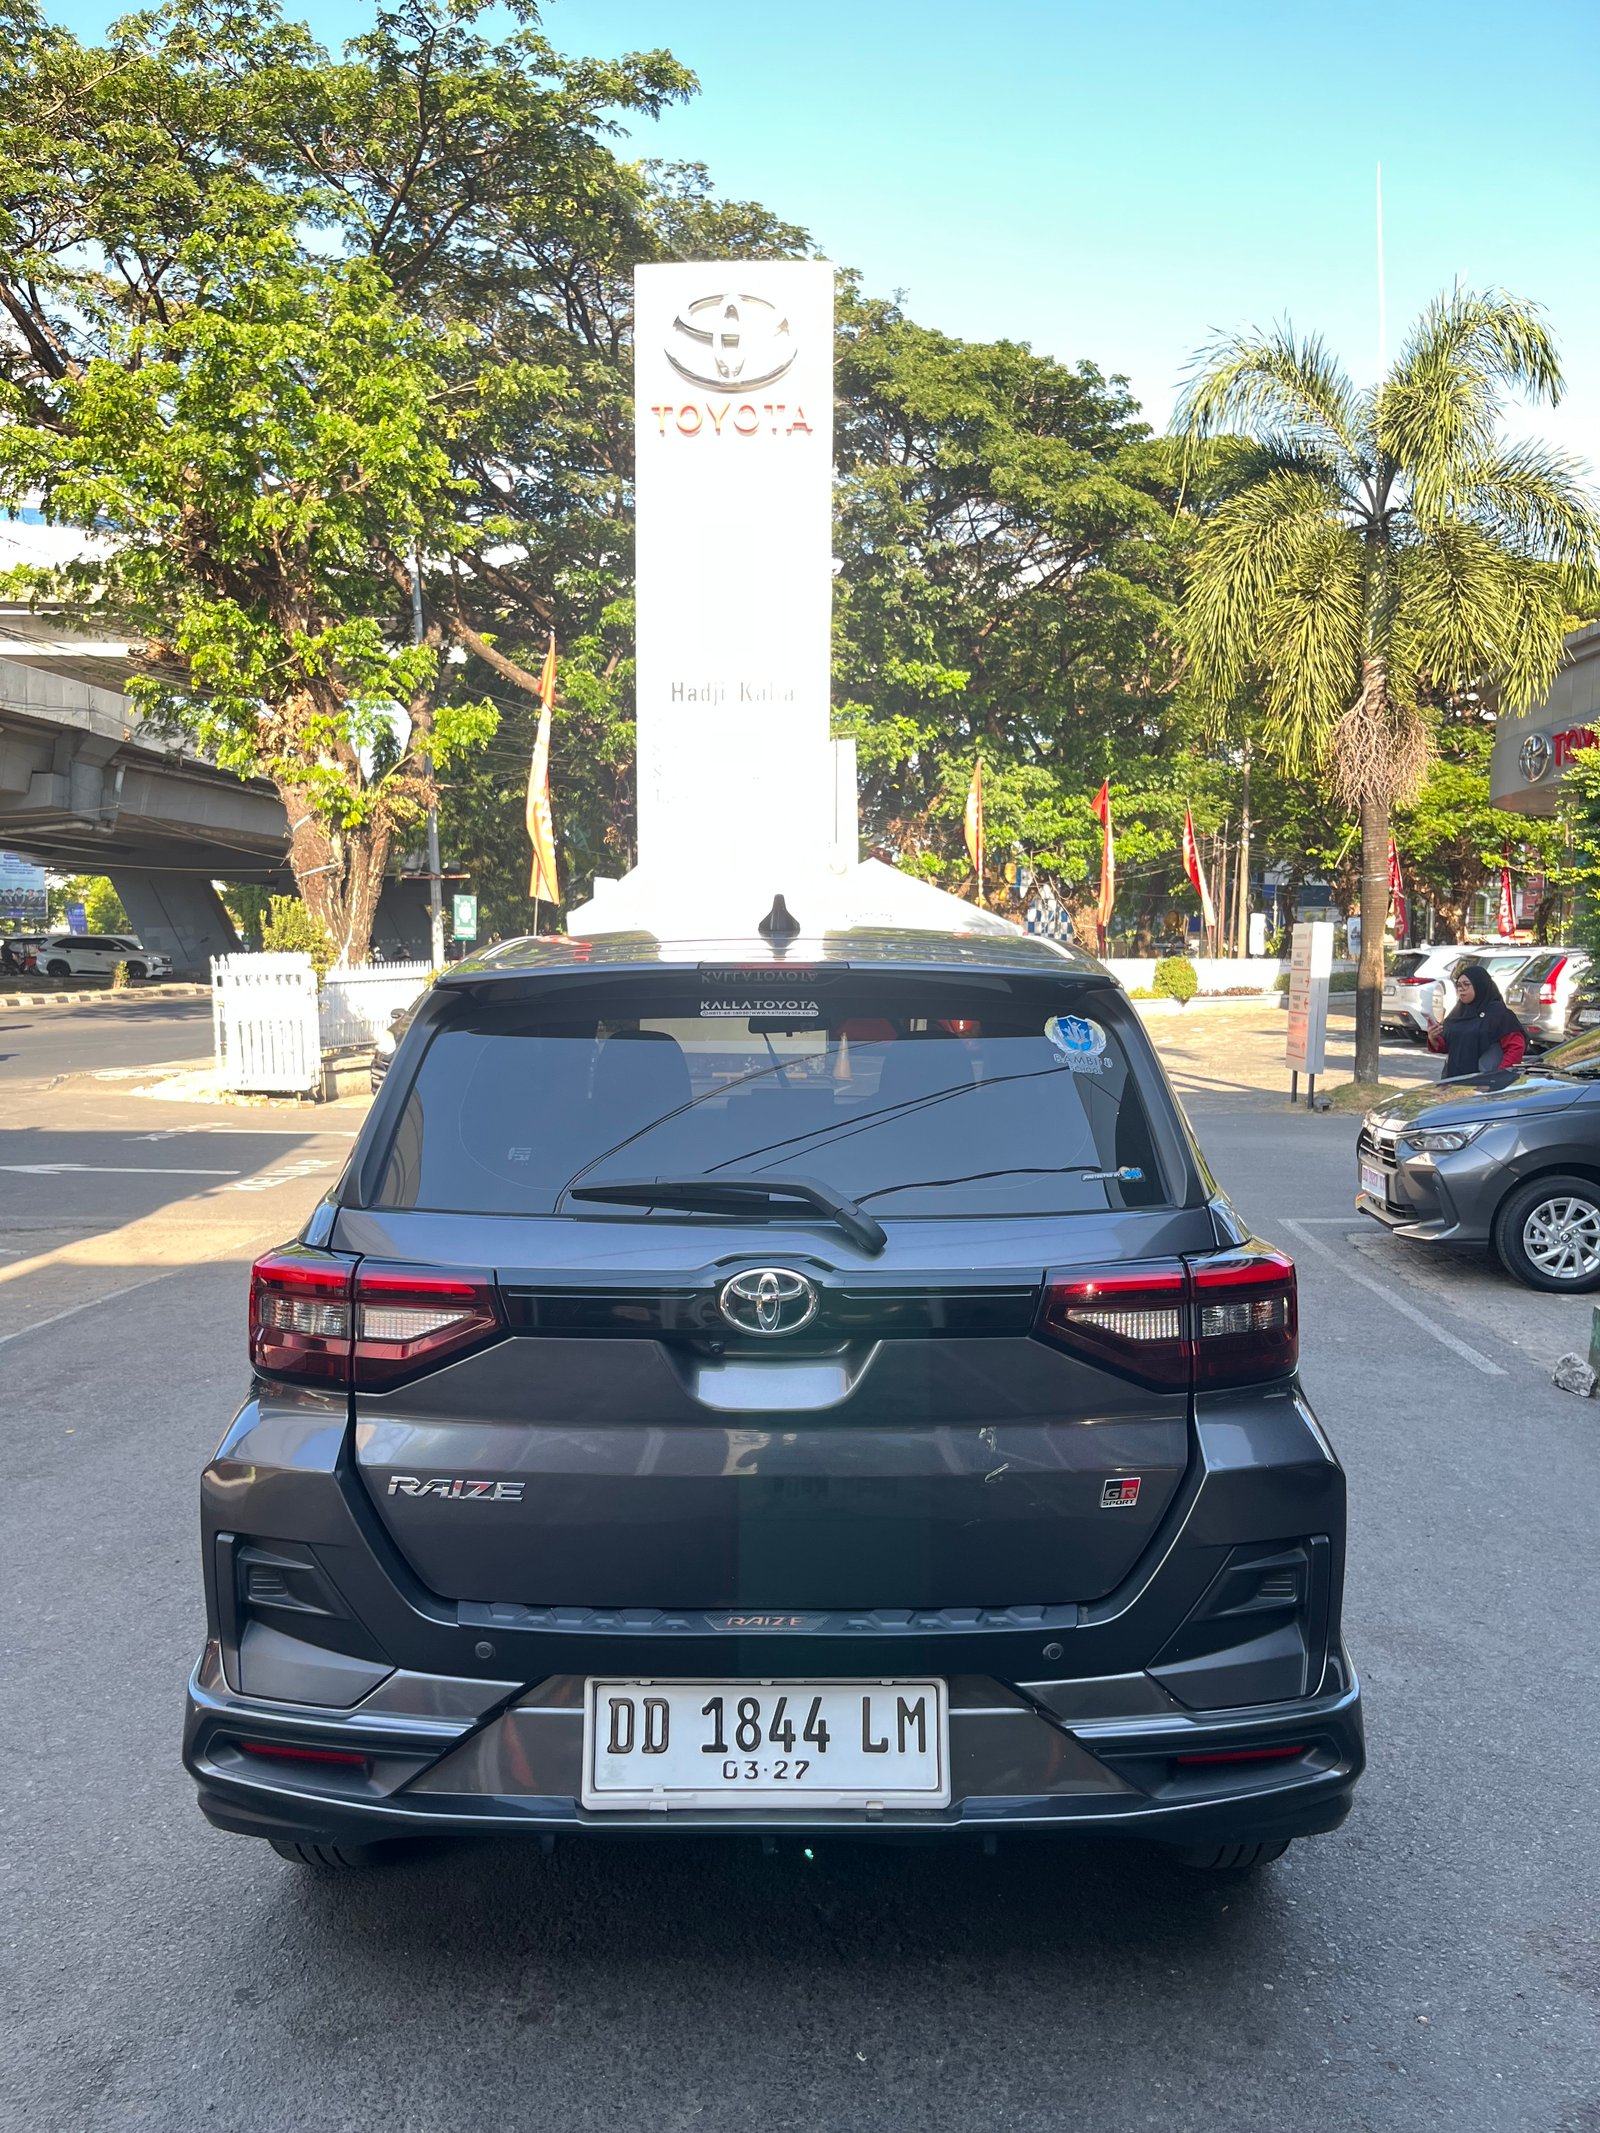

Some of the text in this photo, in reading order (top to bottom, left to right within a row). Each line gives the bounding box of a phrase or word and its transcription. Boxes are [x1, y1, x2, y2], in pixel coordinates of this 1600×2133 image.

[651, 403, 813, 437] TOYOTA
[671, 681, 795, 707] Hadji Kala
[700, 1001, 818, 1010] KALLA TOYOTA
[387, 1475, 526, 1503] RAIZE
[1105, 1487, 1136, 1500] GR
[727, 1616, 803, 1626] RAIZE
[607, 1696, 927, 1754] DD 1844 LM
